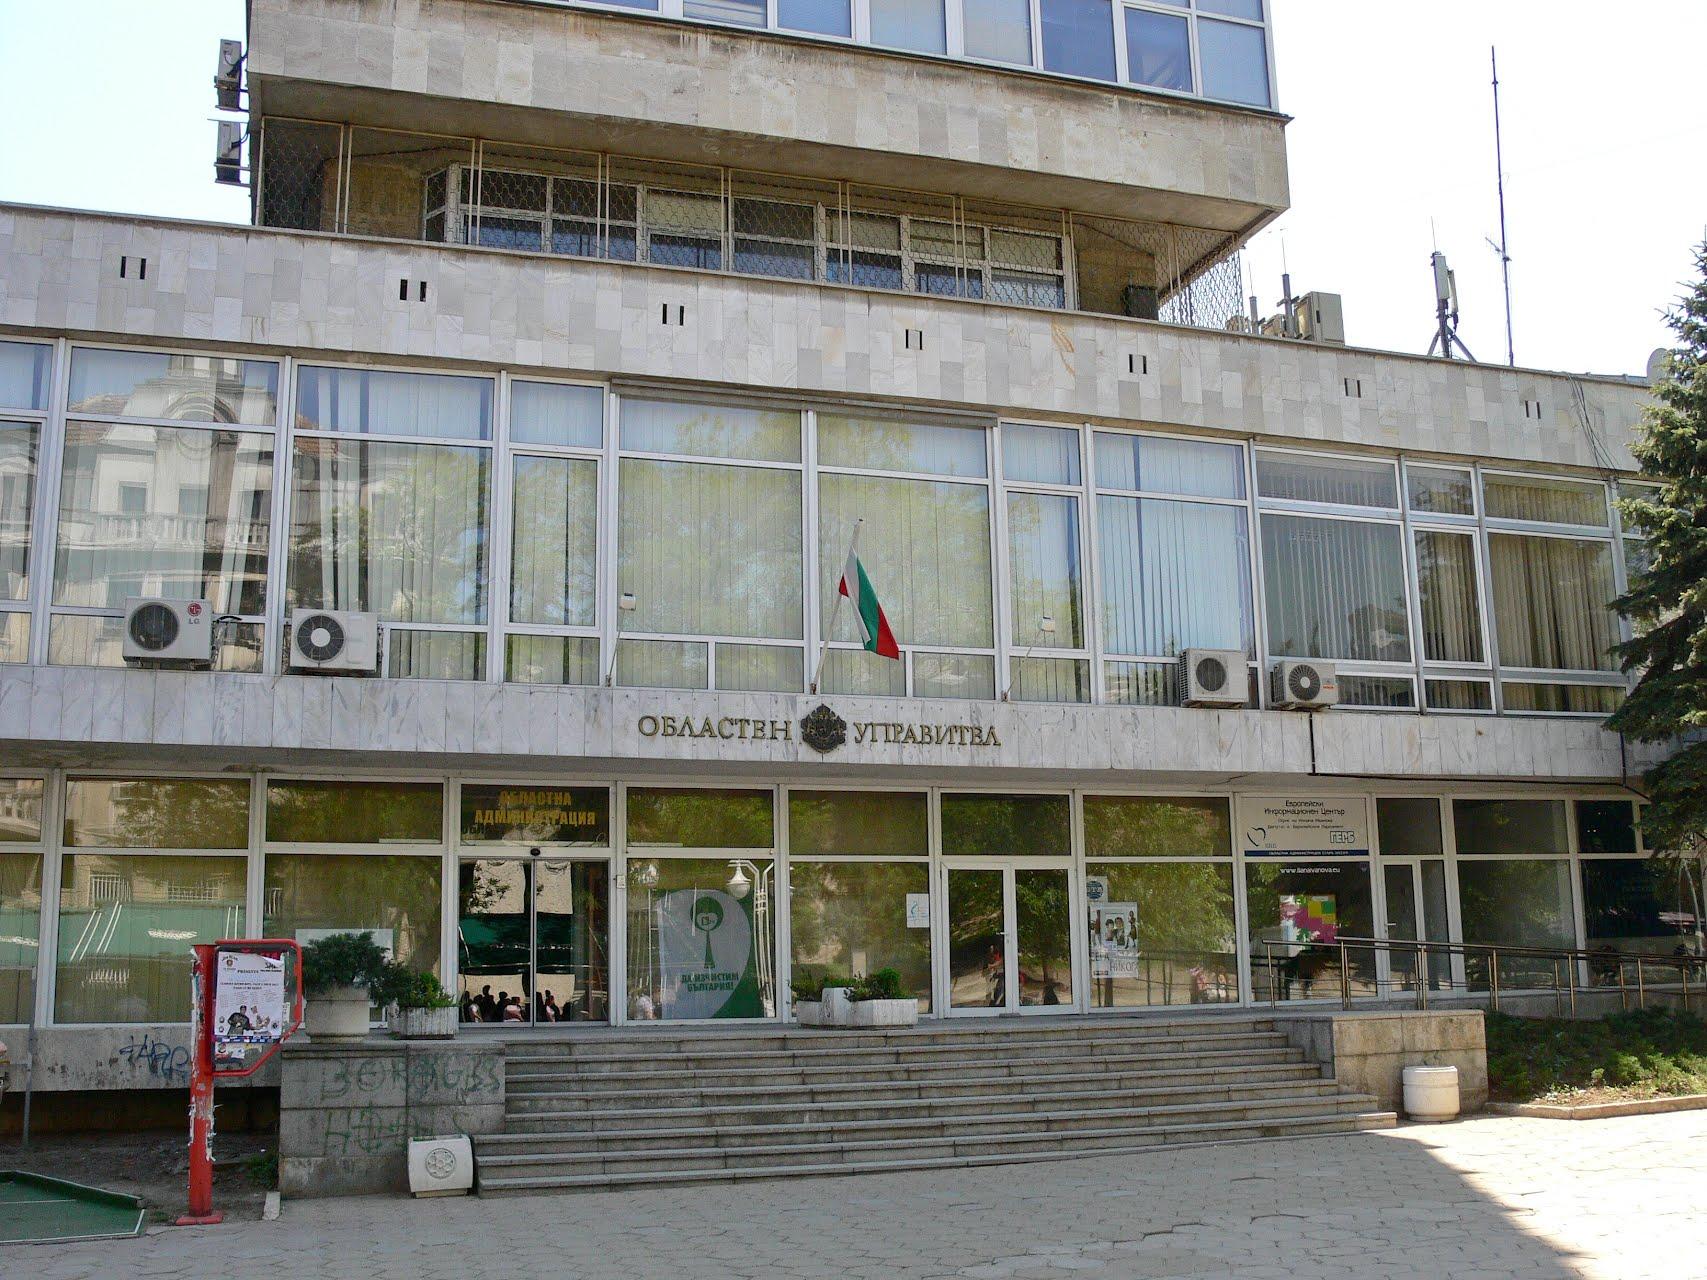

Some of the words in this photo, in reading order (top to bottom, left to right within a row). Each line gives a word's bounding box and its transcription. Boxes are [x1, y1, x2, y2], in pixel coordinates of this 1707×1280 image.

[638, 715, 793, 741] ОБЛАСТЕН
[854, 721, 1002, 746] УПРАВИТЕЛ
[474, 808, 597, 827] АДМИНИСТРАЦИЯ
[1321, 808, 1346, 816] Център
[1329, 831, 1355, 844] ГЕРБ
